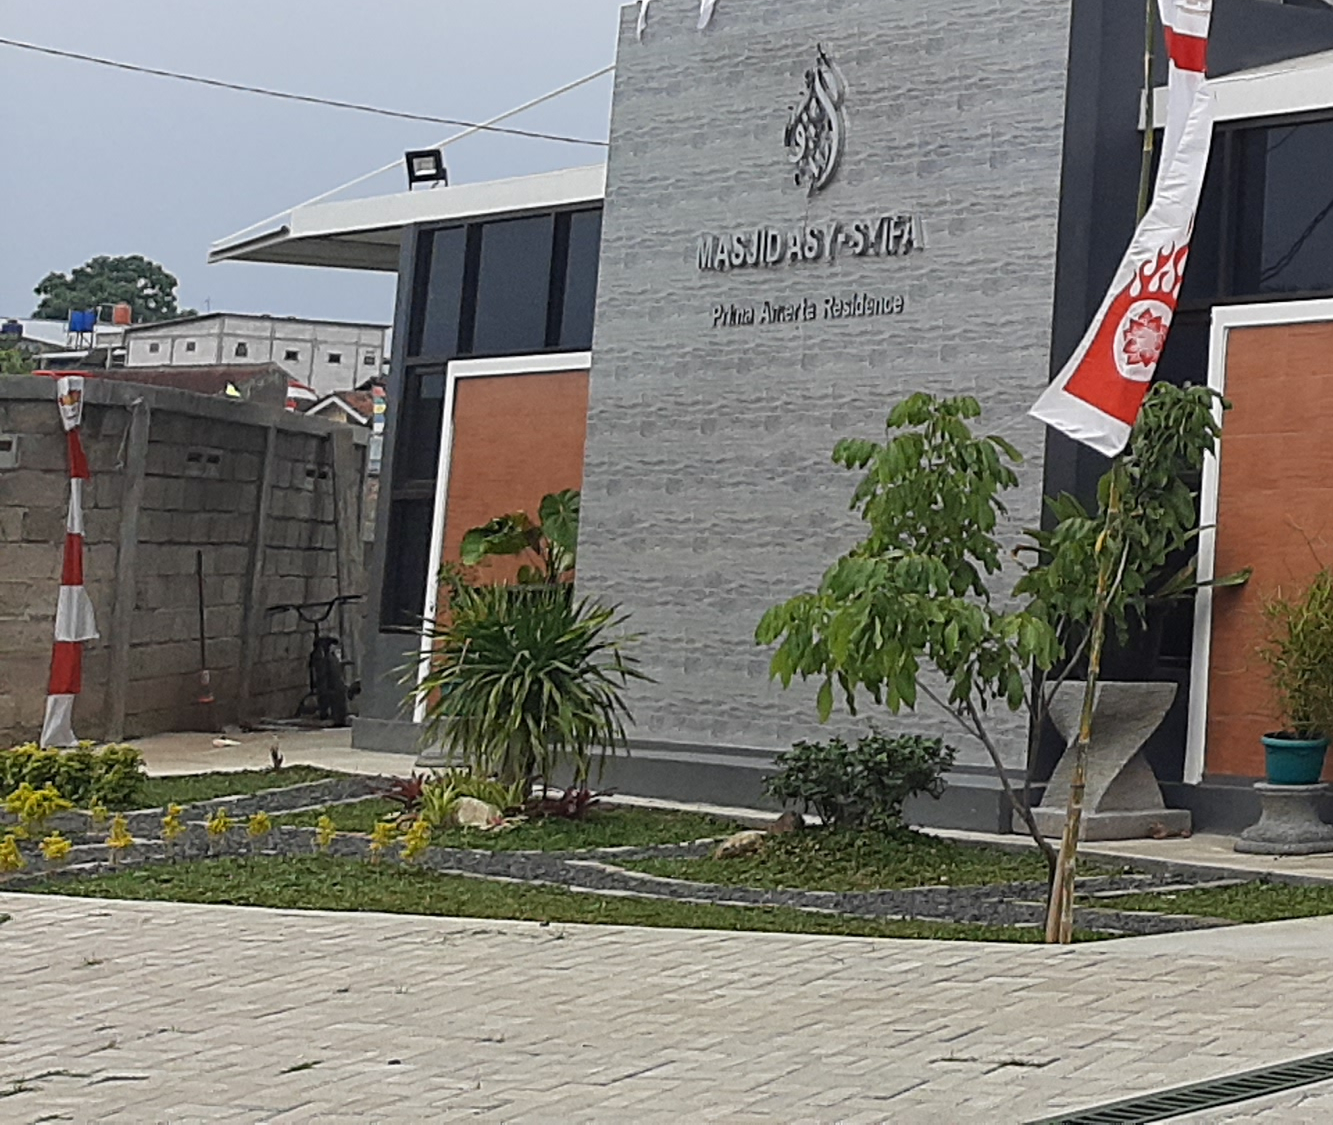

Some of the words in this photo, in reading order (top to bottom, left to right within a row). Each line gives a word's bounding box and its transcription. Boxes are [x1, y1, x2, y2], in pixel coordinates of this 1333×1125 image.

[696, 229, 782, 272] MASJID
[712, 303, 755, 328] Prima
[823, 291, 905, 321] Residence
